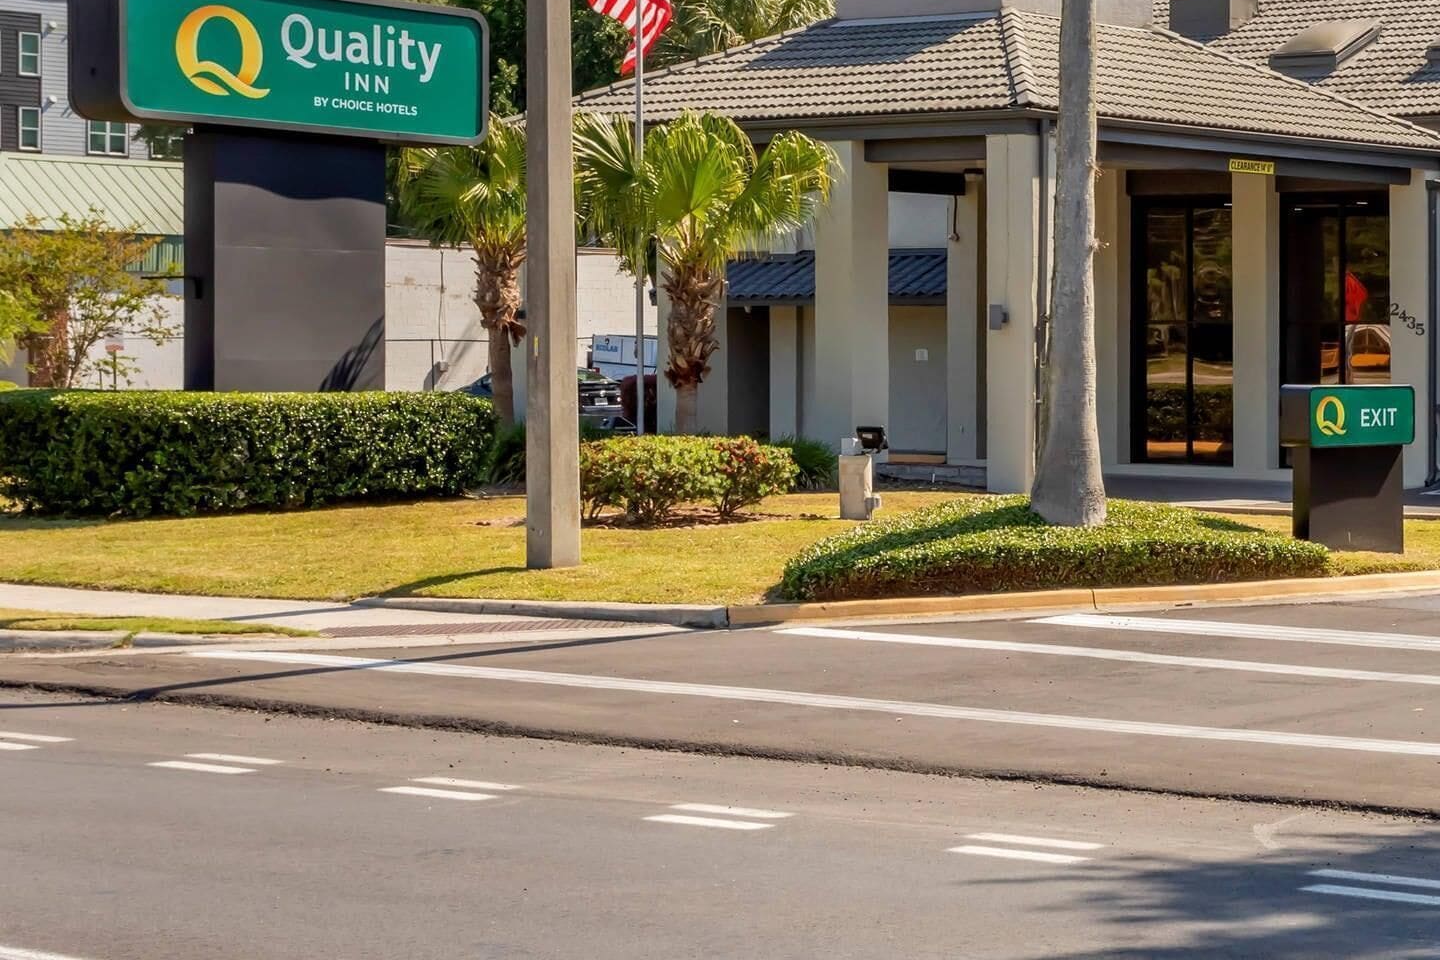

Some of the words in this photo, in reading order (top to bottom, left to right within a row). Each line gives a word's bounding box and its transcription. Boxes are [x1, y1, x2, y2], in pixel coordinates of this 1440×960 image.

[175, 5, 270, 99] Q
[281, 13, 442, 83] Quality
[344, 71, 390, 95] INN
[313, 96, 329, 107] BY
[331, 98, 374, 112] CHOICE
[376, 102, 418, 116] HOTELS
[1231, 160, 1261, 171] CLEARANCE
[1390, 302, 1425, 336] 2435
[1316, 395, 1347, 435] Q
[1360, 407, 1398, 427] EXIT
